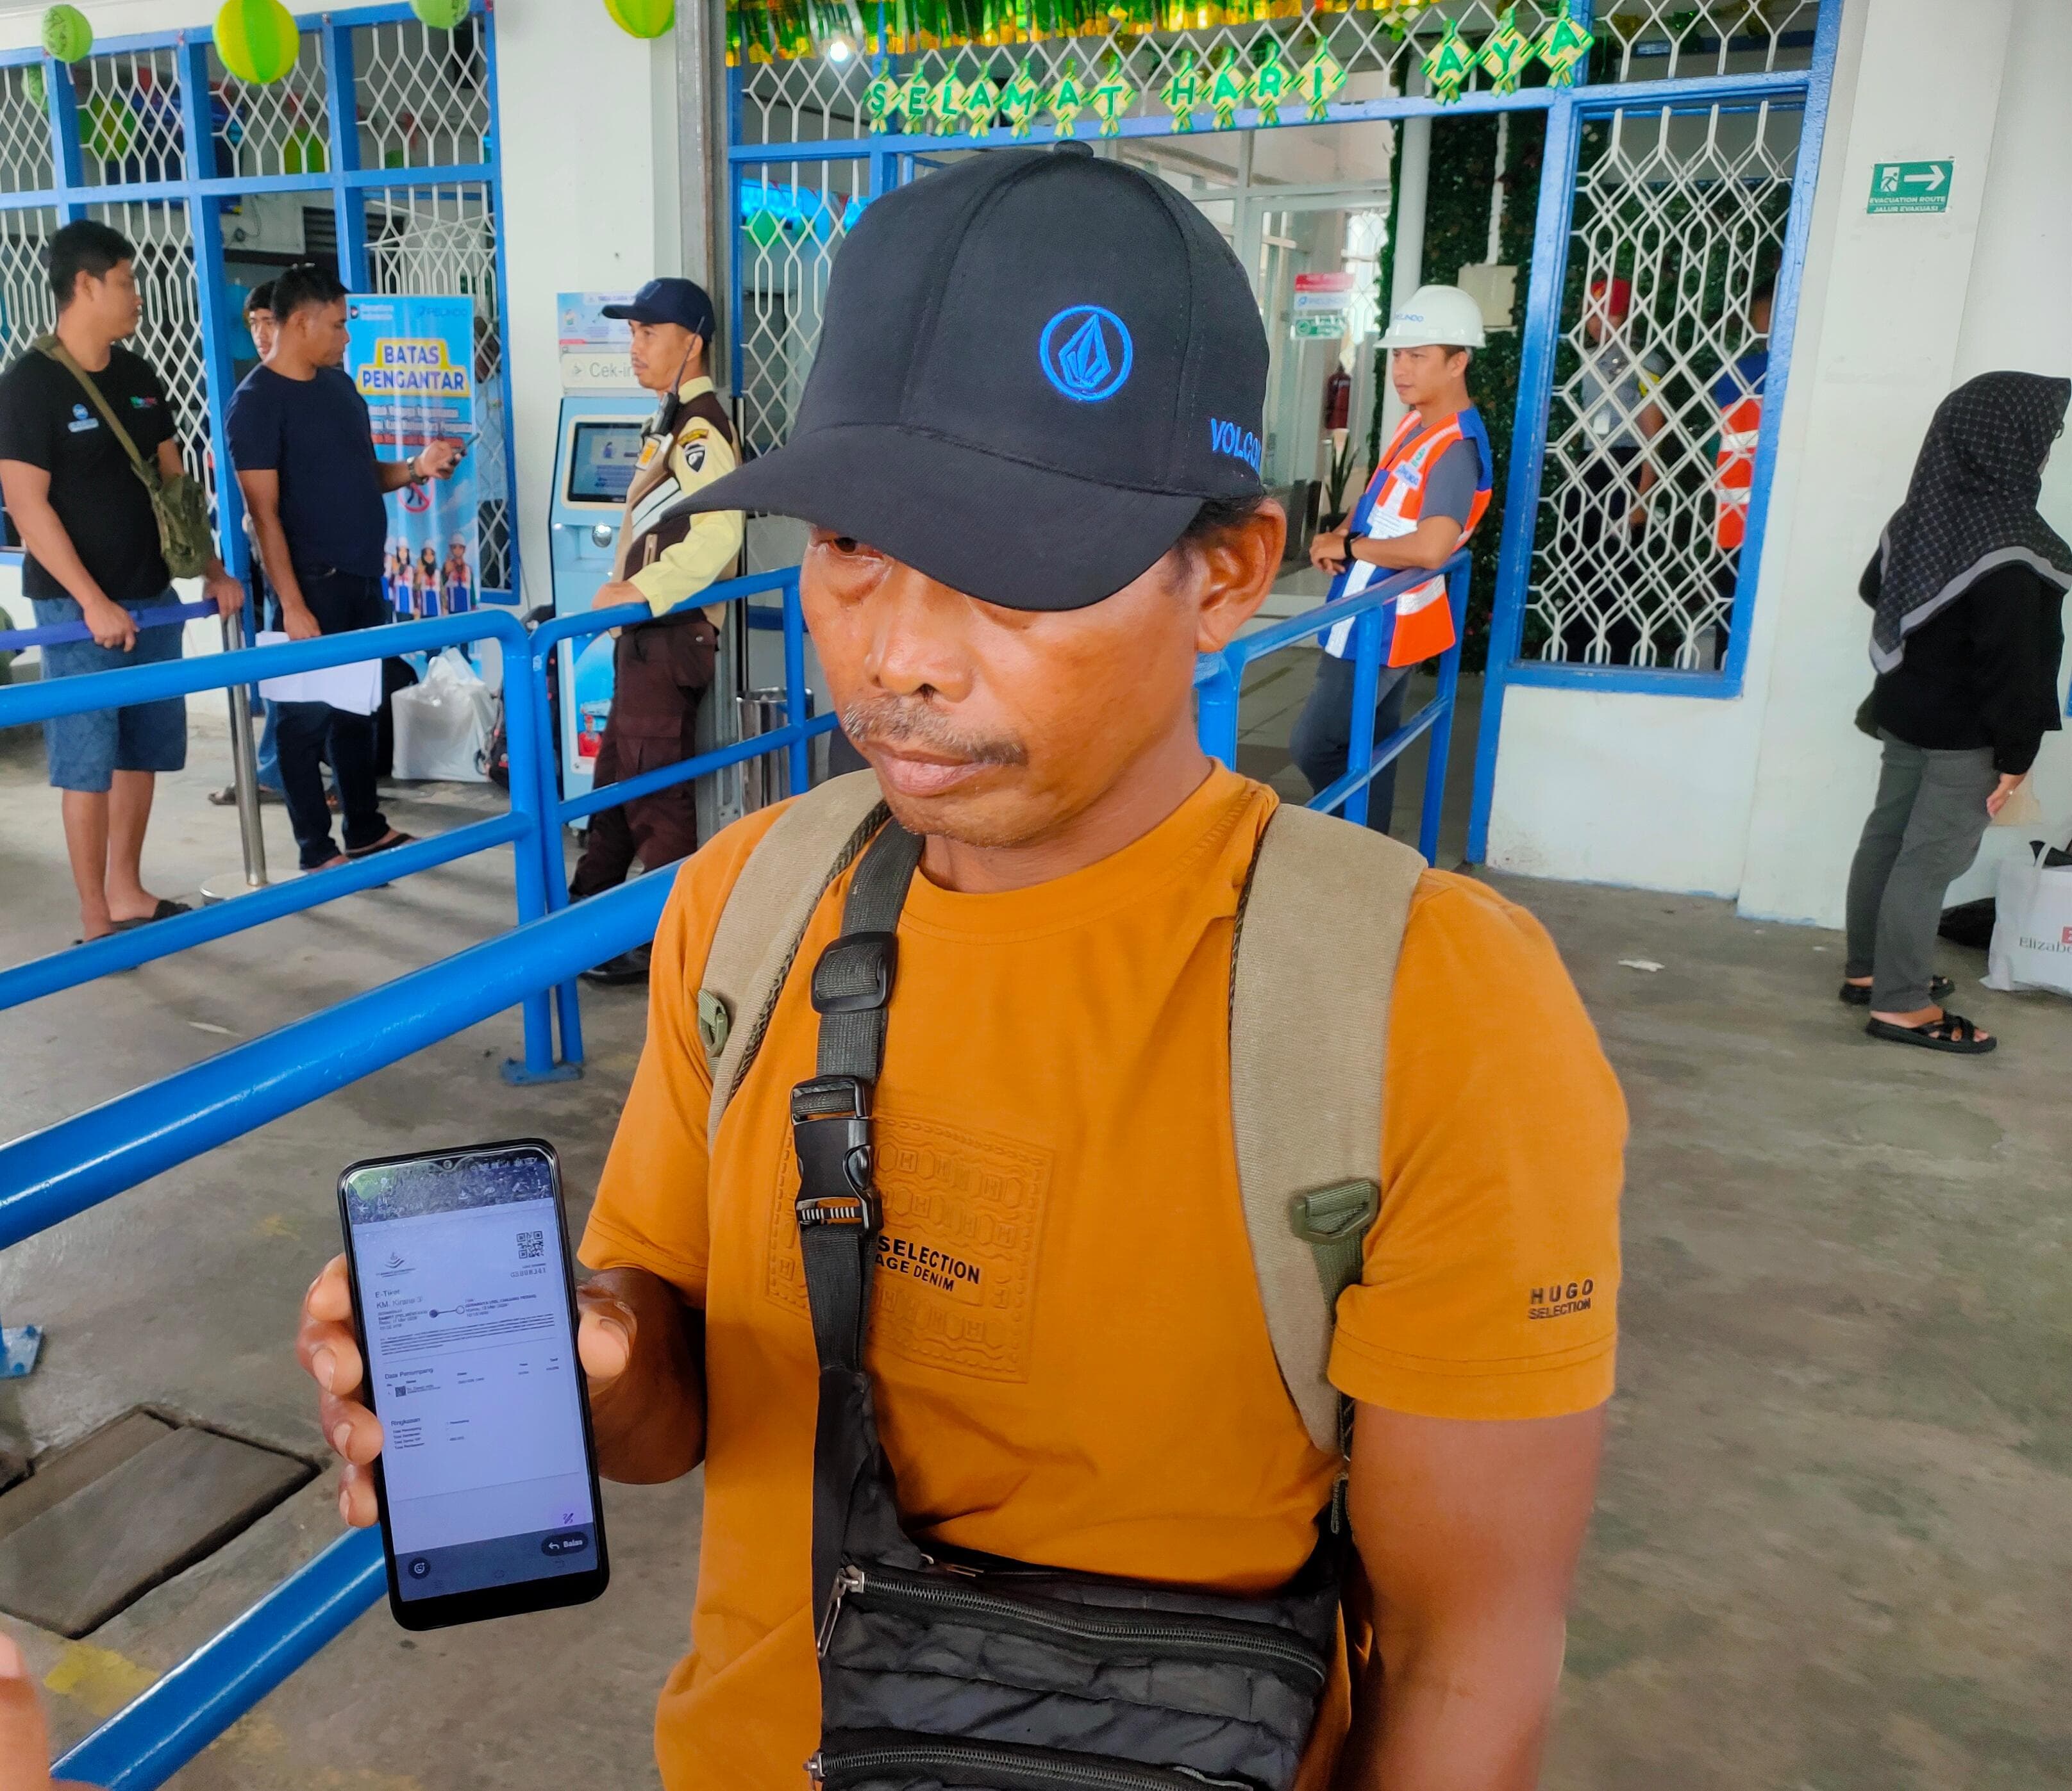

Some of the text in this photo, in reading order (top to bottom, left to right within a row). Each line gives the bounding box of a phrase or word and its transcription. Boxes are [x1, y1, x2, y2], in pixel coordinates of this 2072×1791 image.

[871, 81, 1122, 117] SELAMAT
[1171, 66, 1323, 106] HARI
[384, 345, 440, 364] BATAS
[363, 370, 464, 390] PENGANTAR
[877, 1236, 980, 1284] SELECTION
[914, 1265, 955, 1292] DENIM
[1530, 1279, 1594, 1304] HUGO
[1528, 1297, 1591, 1319] SELECTION
